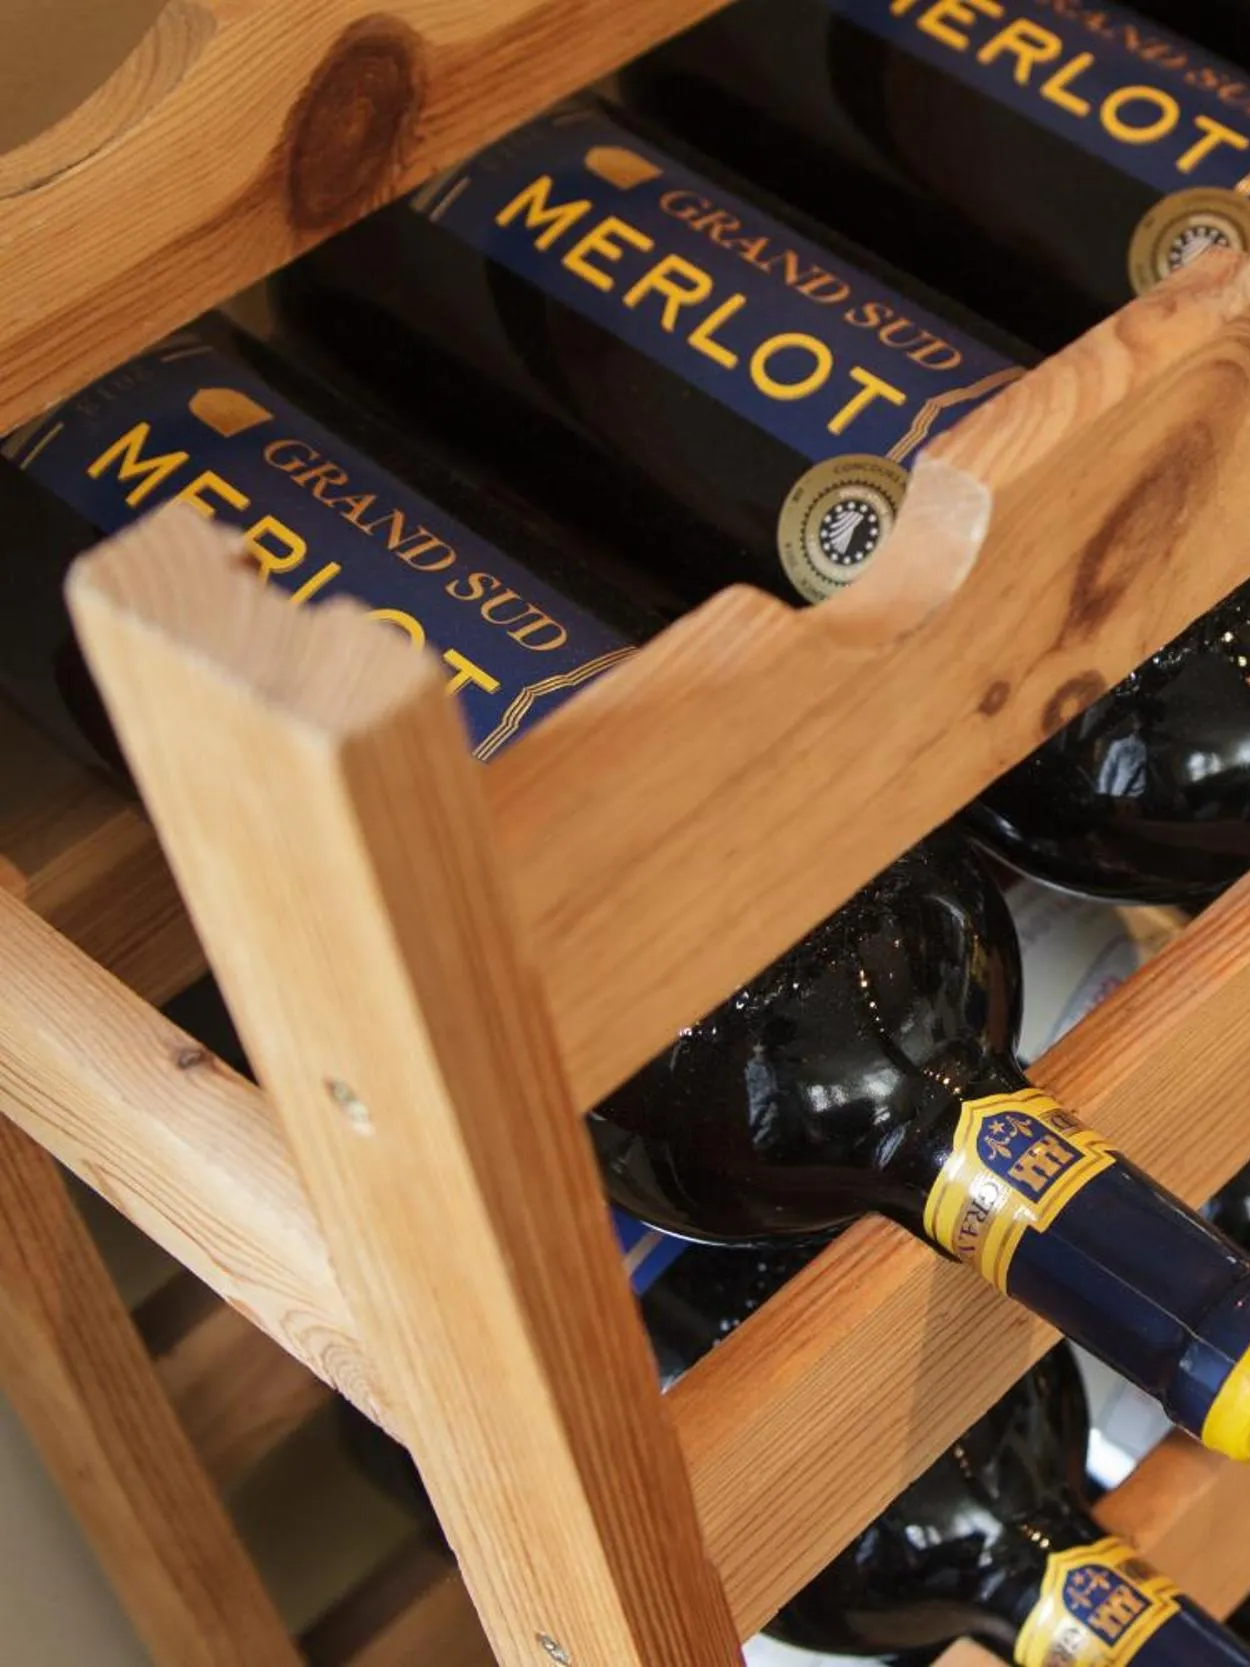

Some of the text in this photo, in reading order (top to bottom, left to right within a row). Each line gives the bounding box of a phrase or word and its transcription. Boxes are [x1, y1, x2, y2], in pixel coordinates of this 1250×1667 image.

[889, 0, 1250, 173] ERLOT
[1035, 0, 1188, 68] RAND
[495, 174, 908, 436] MERLOT
[658, 189, 963, 372] GRAND SUD
[263, 438, 568, 653] GRAND SUD
